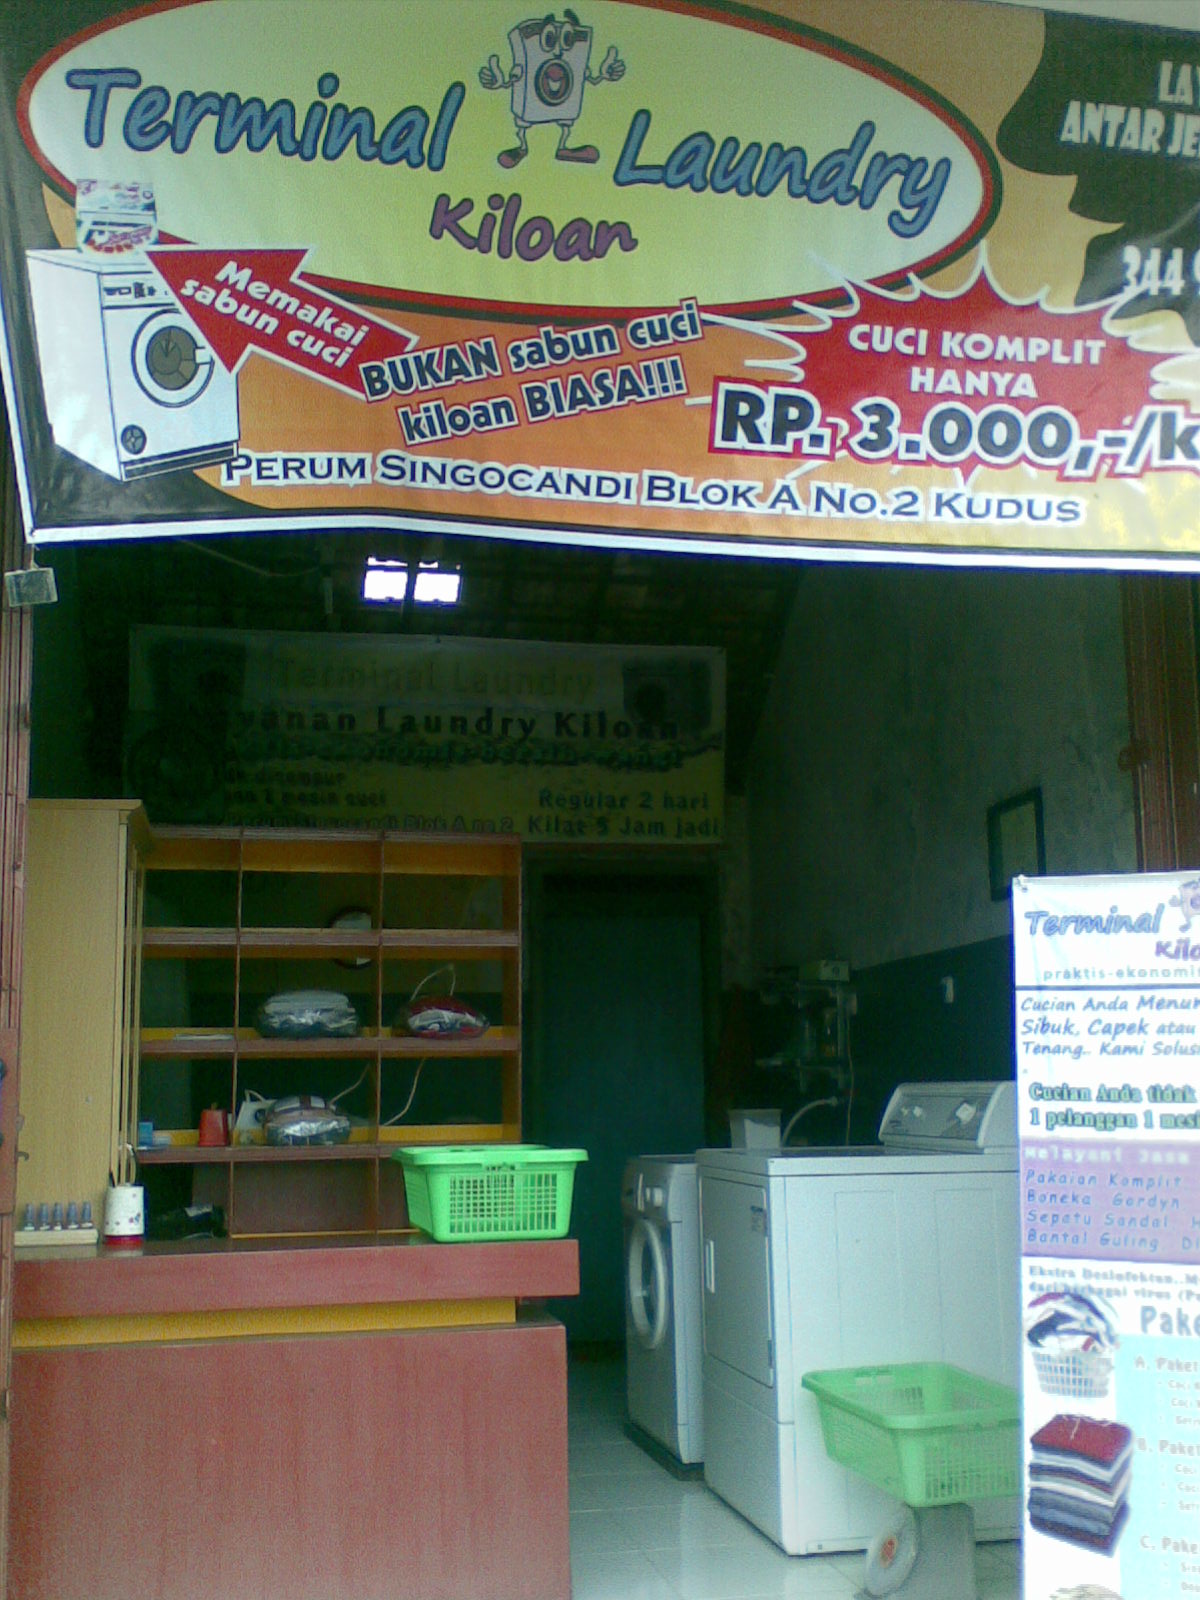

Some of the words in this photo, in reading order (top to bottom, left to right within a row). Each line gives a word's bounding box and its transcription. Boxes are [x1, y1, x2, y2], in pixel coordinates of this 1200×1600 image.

[1159, 61, 1200, 106] LA
[1060, 100, 1165, 154] ANTAR
[1168, 112, 1200, 158] JE
[66, 68, 465, 171] Terminal
[614, 109, 951, 238] Laundry
[430, 194, 637, 261] Kiloan
[215, 260, 369, 346] Memakai
[180, 278, 279, 336] sabun
[286, 328, 353, 368] cuci
[361, 338, 501, 400] BUKAN
[508, 326, 619, 372] sabun
[627, 301, 700, 348] cuci
[848, 324, 927, 356] CUCI
[941, 330, 1106, 365] KOMPLIT
[909, 366, 1038, 399] HANYA
[399, 399, 516, 444] kiloan
[523, 357, 687, 421] BIASA!!!
[226, 457, 367, 481] PERUM
[379, 454, 634, 501] SINGOCANDI
[646, 474, 760, 506] BLOK
[768, 482, 801, 511] A
[935, 491, 1081, 521] KUDUS
[377, 705, 535, 743] Laundry
[555, 711, 678, 740] Kiloan
[539, 789, 627, 810] Regular
[638, 792, 654, 809] 2
[663, 790, 709, 810] hari
[528, 815, 587, 835] Kilat
[619, 816, 665, 834] Jam
[676, 816, 720, 837] jadi
[1024, 903, 1165, 936] Terminal
[1021, 997, 1075, 1011] Cucian
[1082, 996, 1128, 1011] Anda
[1088, 1018, 1149, 1040] Capek
[1156, 1021, 1196, 1036] atau
[1099, 1040, 1147, 1056] Kami
[1029, 1082, 1091, 1102] Cucian
[1096, 1084, 1142, 1103] Anda
[1147, 1084, 1198, 1103] tidak
[1030, 1108, 1040, 1125] 1
[1045, 1108, 1137, 1131] pelanggan
[1143, 1110, 1154, 1129] 1
[1025, 1146, 1122, 1163] Melayani
[1026, 1169, 1097, 1185] Pakaian
[1027, 1210, 1092, 1226] Sepatu
[1028, 1229, 1088, 1245] Bantal
